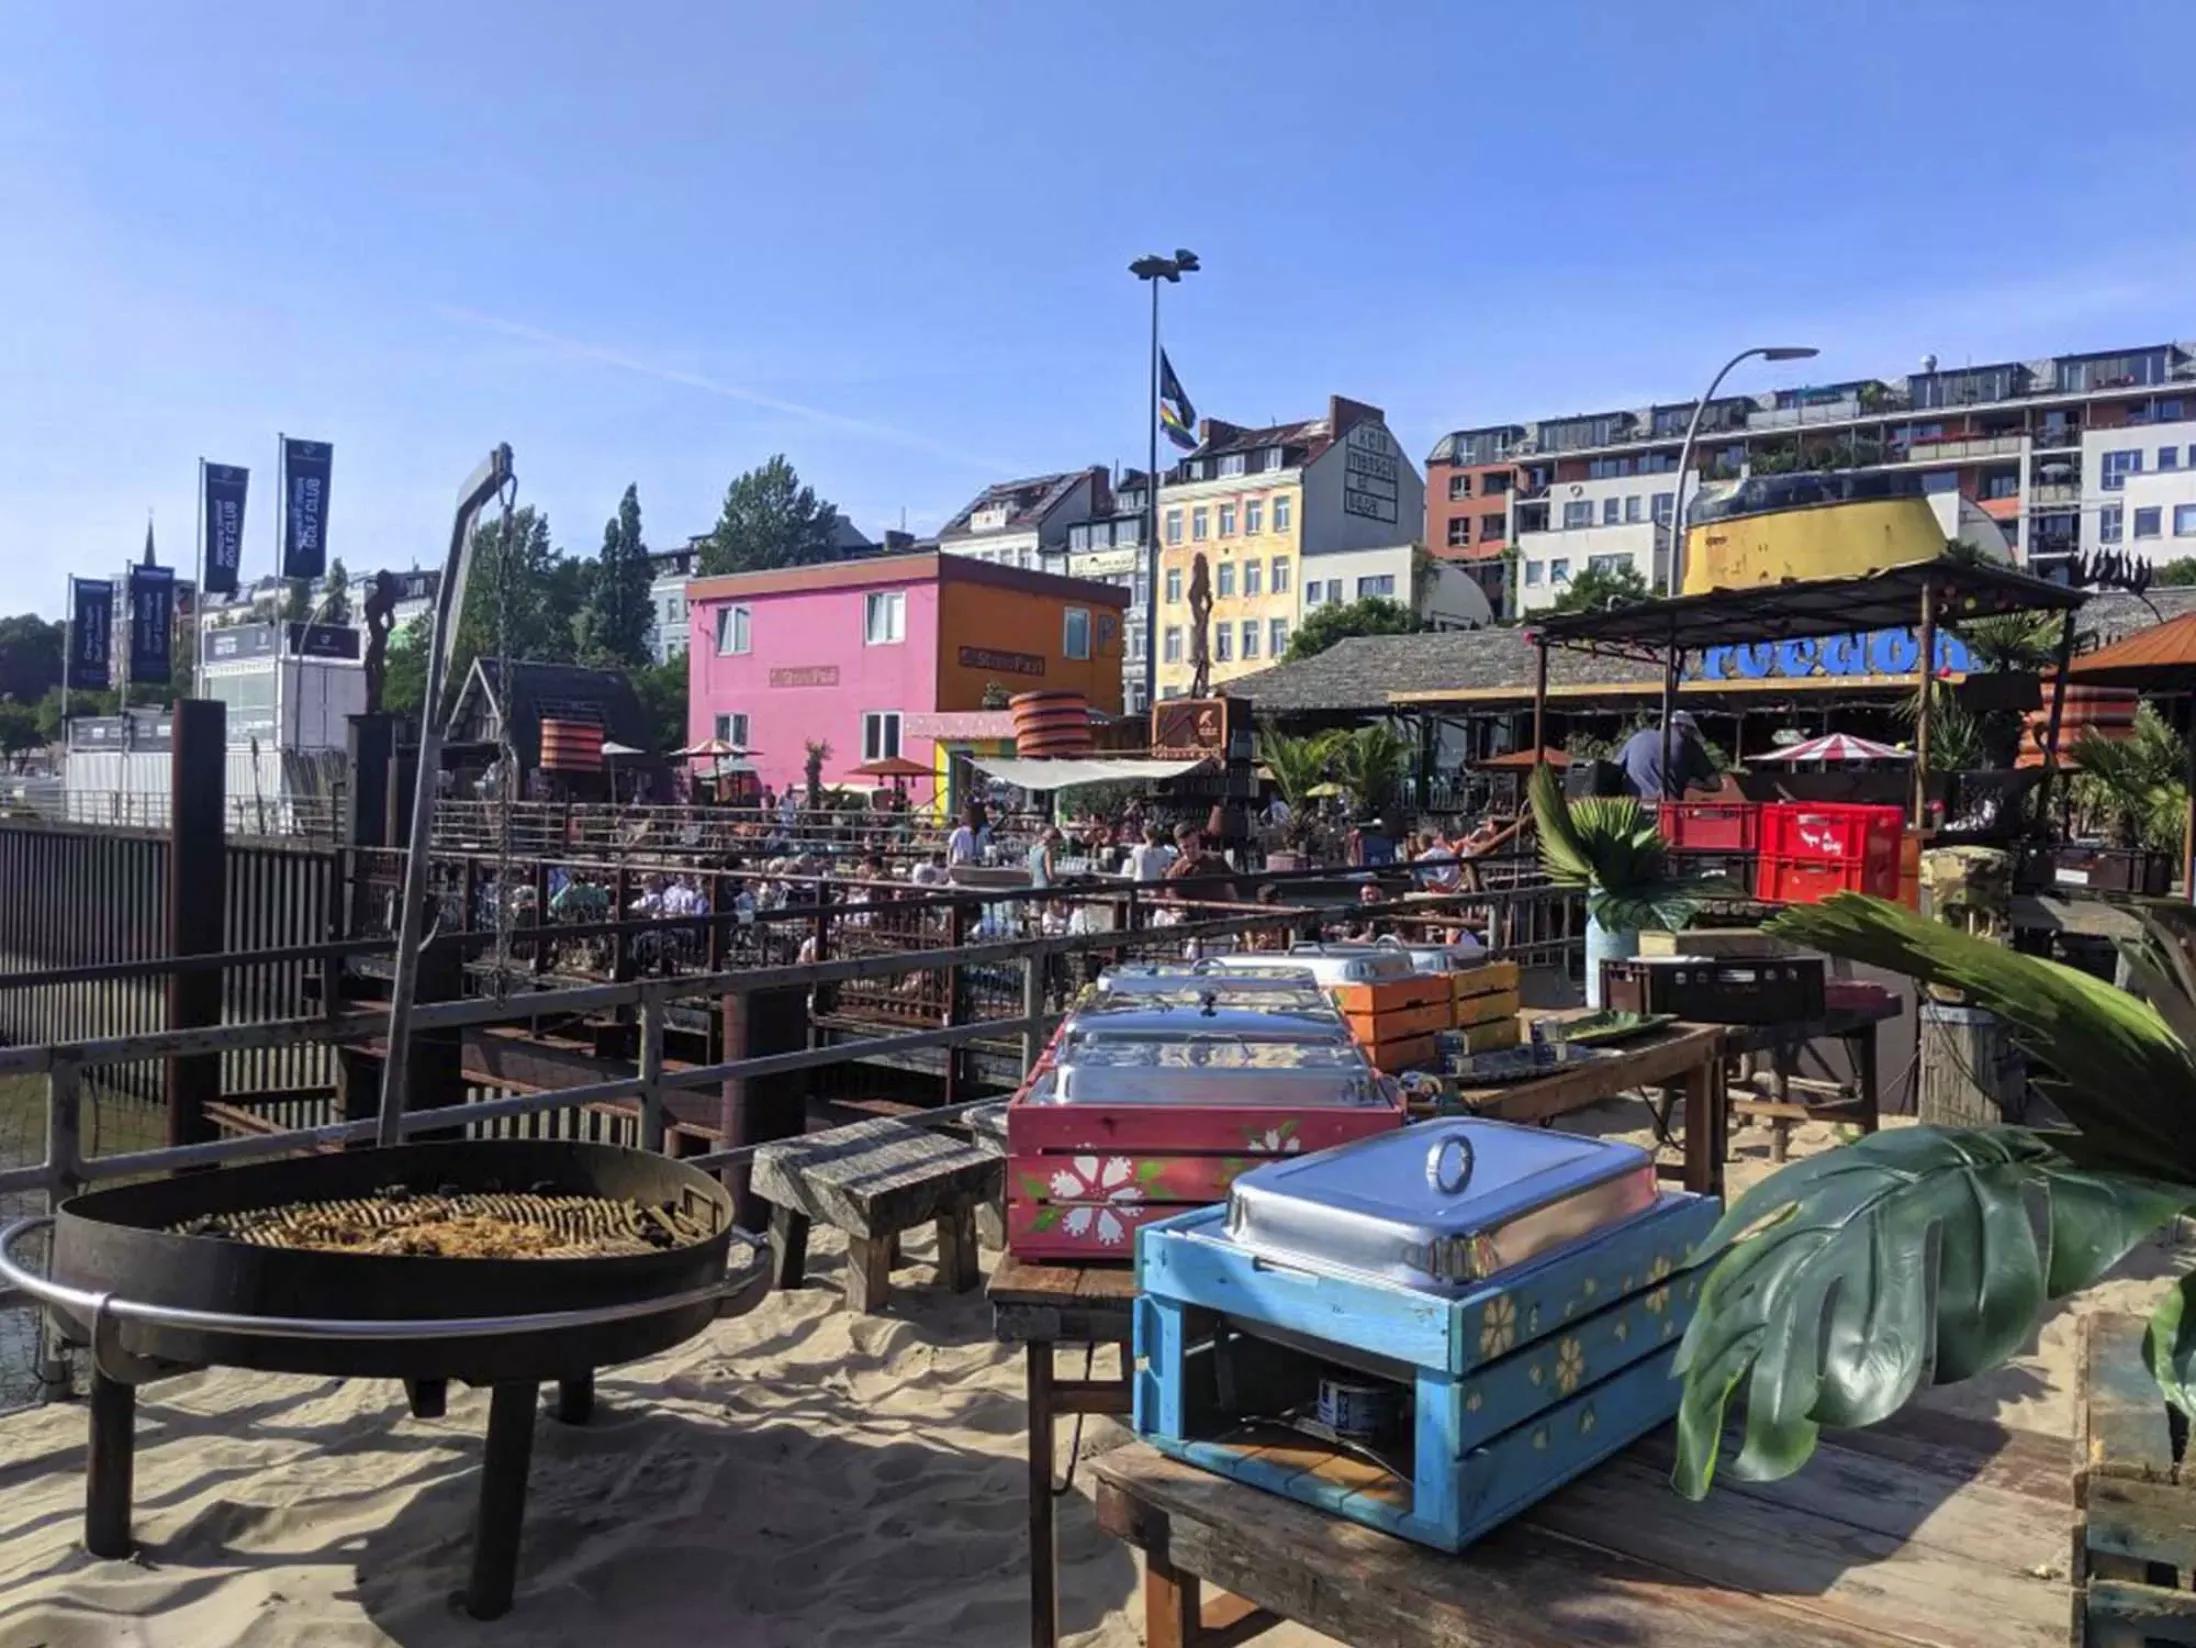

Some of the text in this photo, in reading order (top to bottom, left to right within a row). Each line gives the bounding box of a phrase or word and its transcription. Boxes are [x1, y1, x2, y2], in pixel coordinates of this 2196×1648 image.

[224, 500, 237, 568] GOLF CLUB
[303, 479, 320, 549] GOLF CLUB
